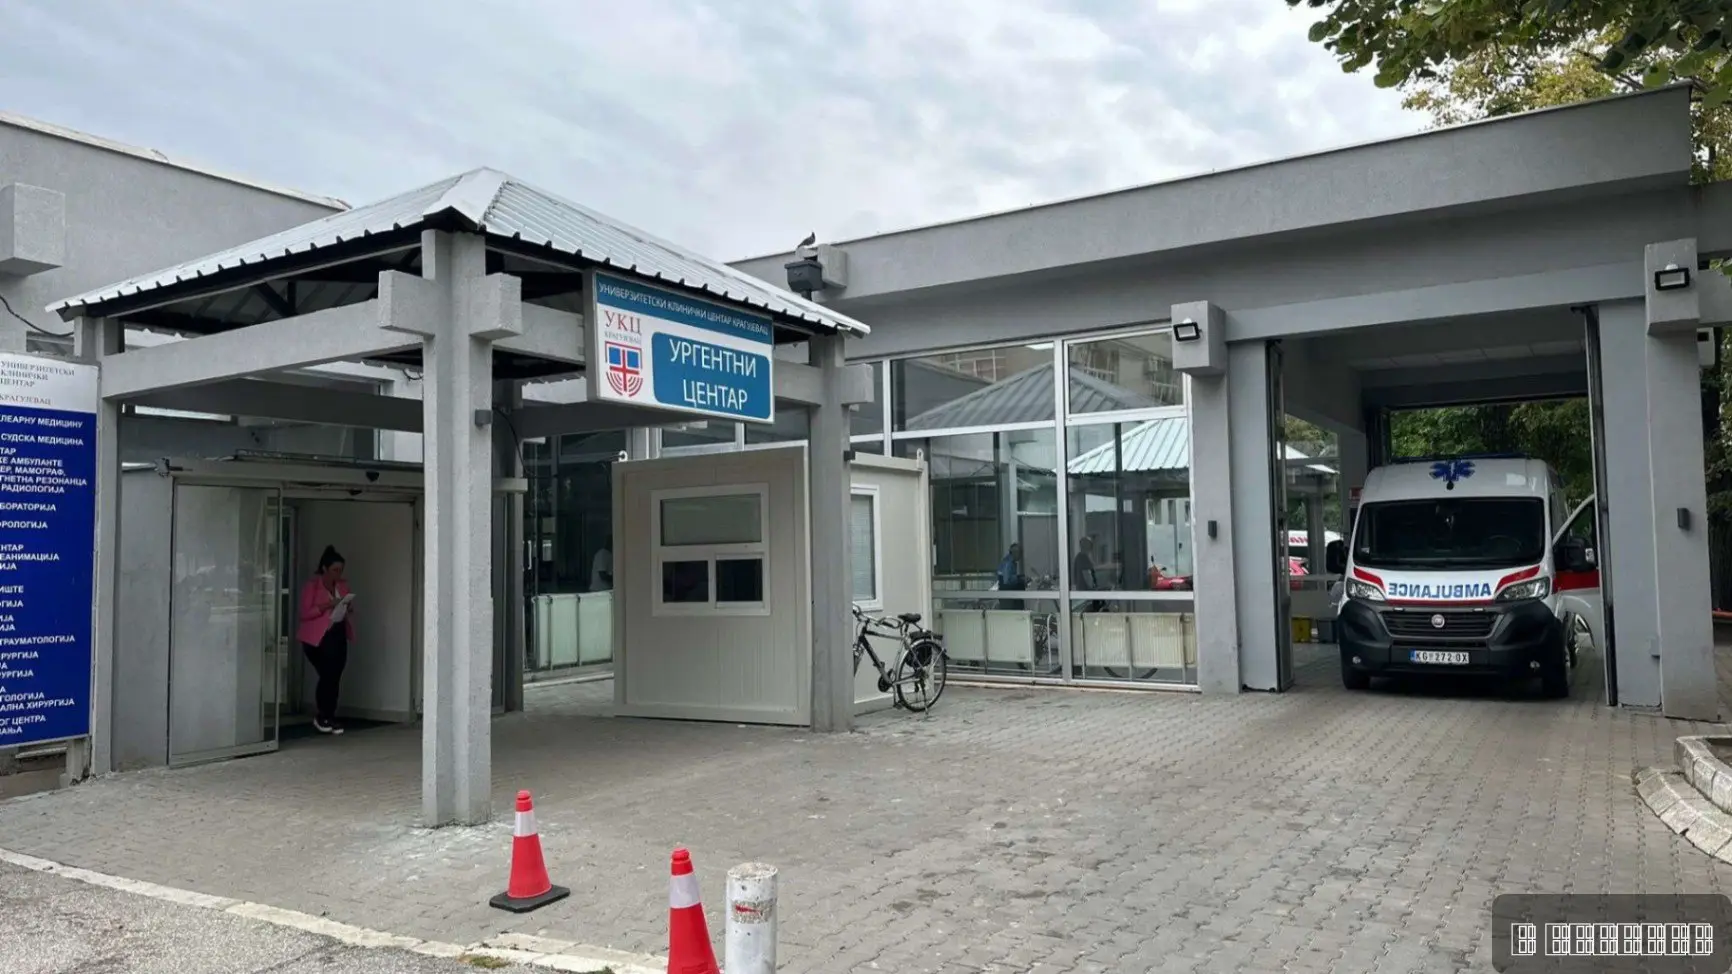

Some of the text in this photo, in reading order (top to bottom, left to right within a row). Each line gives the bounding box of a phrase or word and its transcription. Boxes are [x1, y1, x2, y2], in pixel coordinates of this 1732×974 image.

[598, 282, 667, 309] УНИВЕРЗИТЕТСКИ
[667, 302, 707, 319] КЛИНИЧКИ
[707, 312, 732, 325] ЦЕНТАР
[604, 310, 642, 336] УКЦ
[669, 339, 757, 379] УРГЕНТНИ
[683, 379, 748, 410] ЦЕНТАР
[37, 417, 83, 428] МЕДИЦИНУ
[1, 433, 84, 446] СУДСКА МЕДИЦИНА
[10, 457, 63, 467] АМБУЛАНТЕ
[14, 467, 67, 476] МАМОГРАФ,
[36, 477, 87, 487] РЕЗОНАНЦА
[1, 484, 65, 494] РАДИОЛОГИЈА
[0, 520, 48, 529] РОЛОГИЈА
[0, 600, 24, 608] ГИЈА
[26, 698, 75, 709] ХИРУРГИЈА
[12, 715, 47, 726] ЦЕНТРА
[0, 726, 23, 735] АЊА
